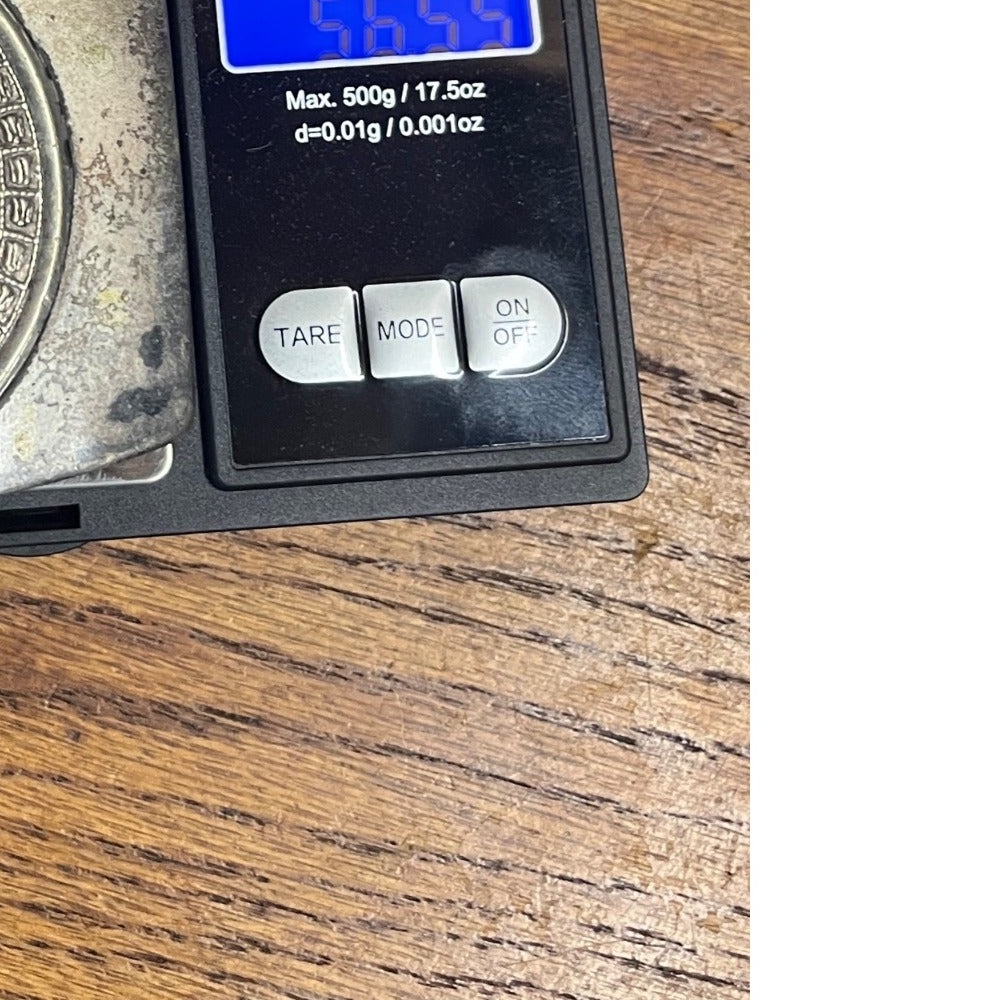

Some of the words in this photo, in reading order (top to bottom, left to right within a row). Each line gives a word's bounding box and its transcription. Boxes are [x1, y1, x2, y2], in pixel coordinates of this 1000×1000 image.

[286, 90, 337, 111] Max.
[343, 85, 396, 109] 500g
[400, 83, 408, 103] /
[414, 80, 486, 101] 17.5oz
[294, 120, 381, 144] d=0.01g
[386, 116, 393, 136] /
[399, 114, 484, 136] 0.001oz
[496, 298, 529, 316] ON
[273, 324, 341, 348] TARE
[377, 317, 444, 340] MODE
